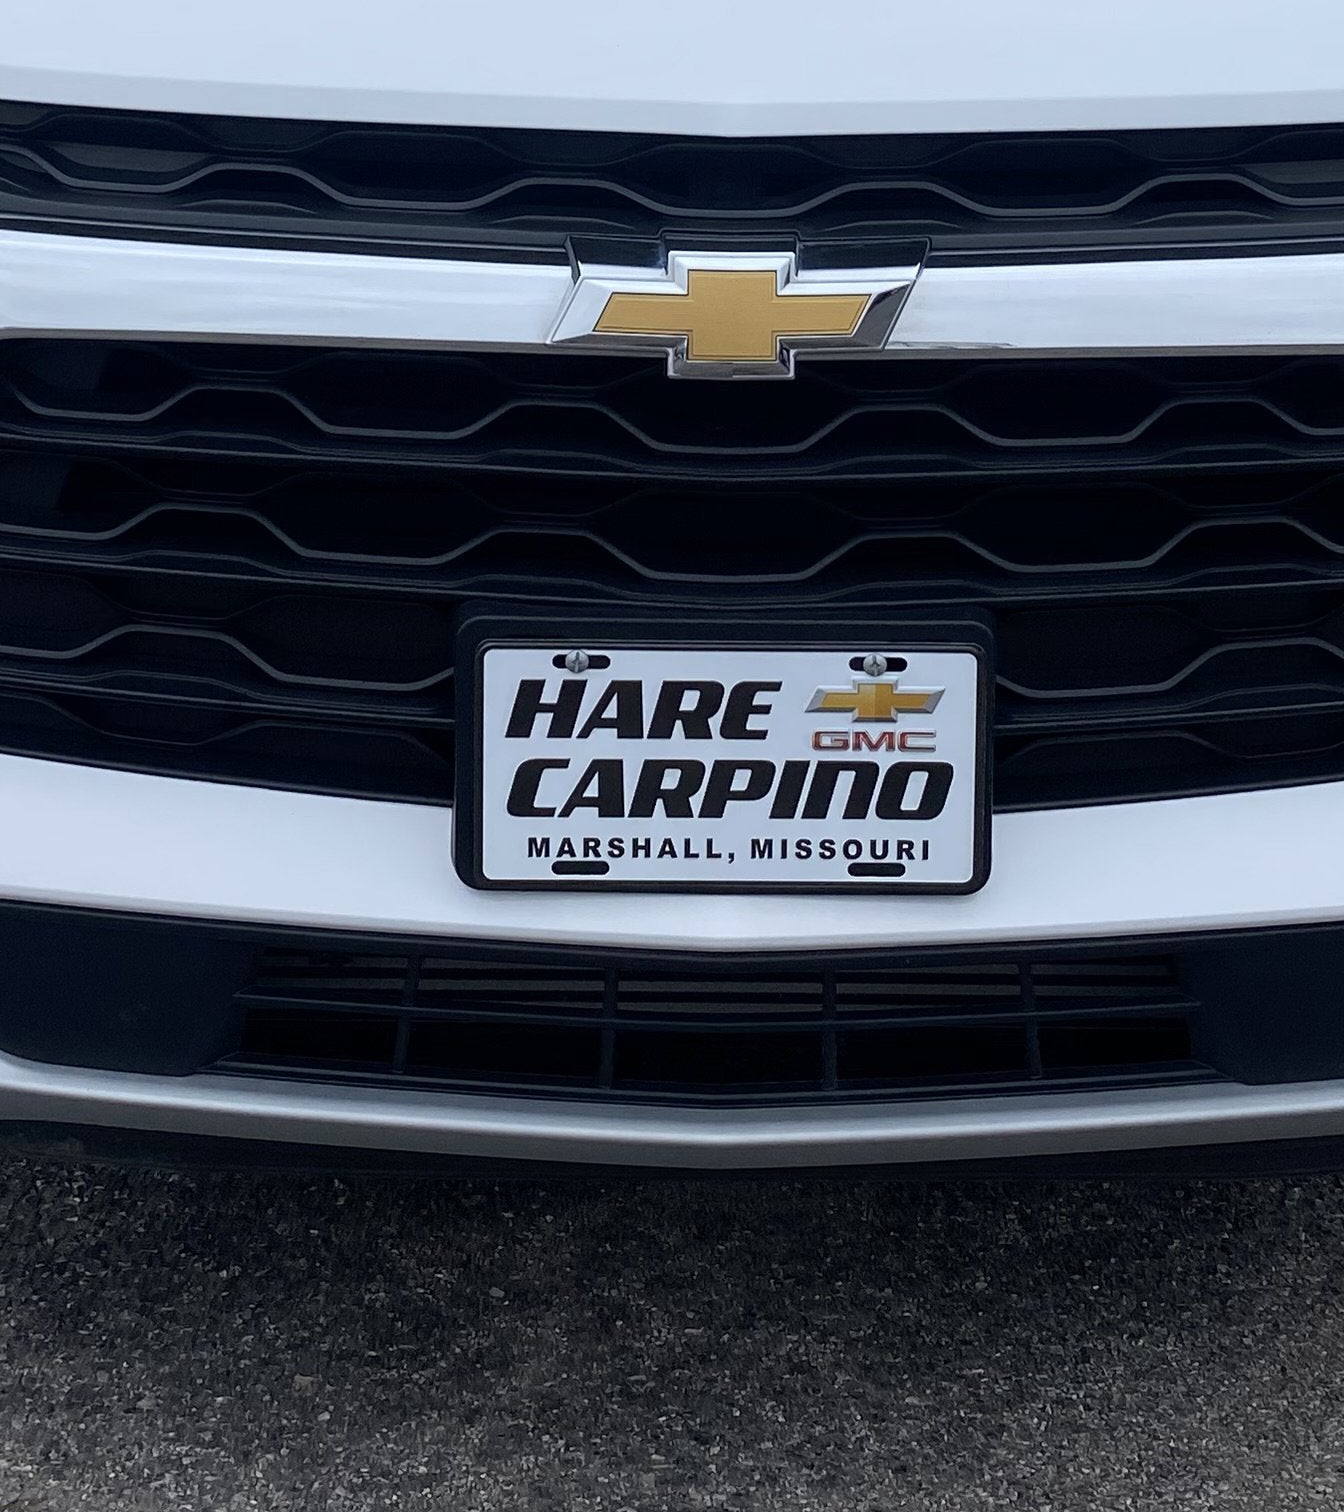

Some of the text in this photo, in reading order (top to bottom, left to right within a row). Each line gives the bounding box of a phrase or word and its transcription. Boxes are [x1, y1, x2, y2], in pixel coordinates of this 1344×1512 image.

[504, 678, 783, 740] HARE
[811, 728, 937, 753] GMC
[505, 758, 954, 820] CARPINO
[527, 837, 930, 864] MARSHALL, MISSOURI
